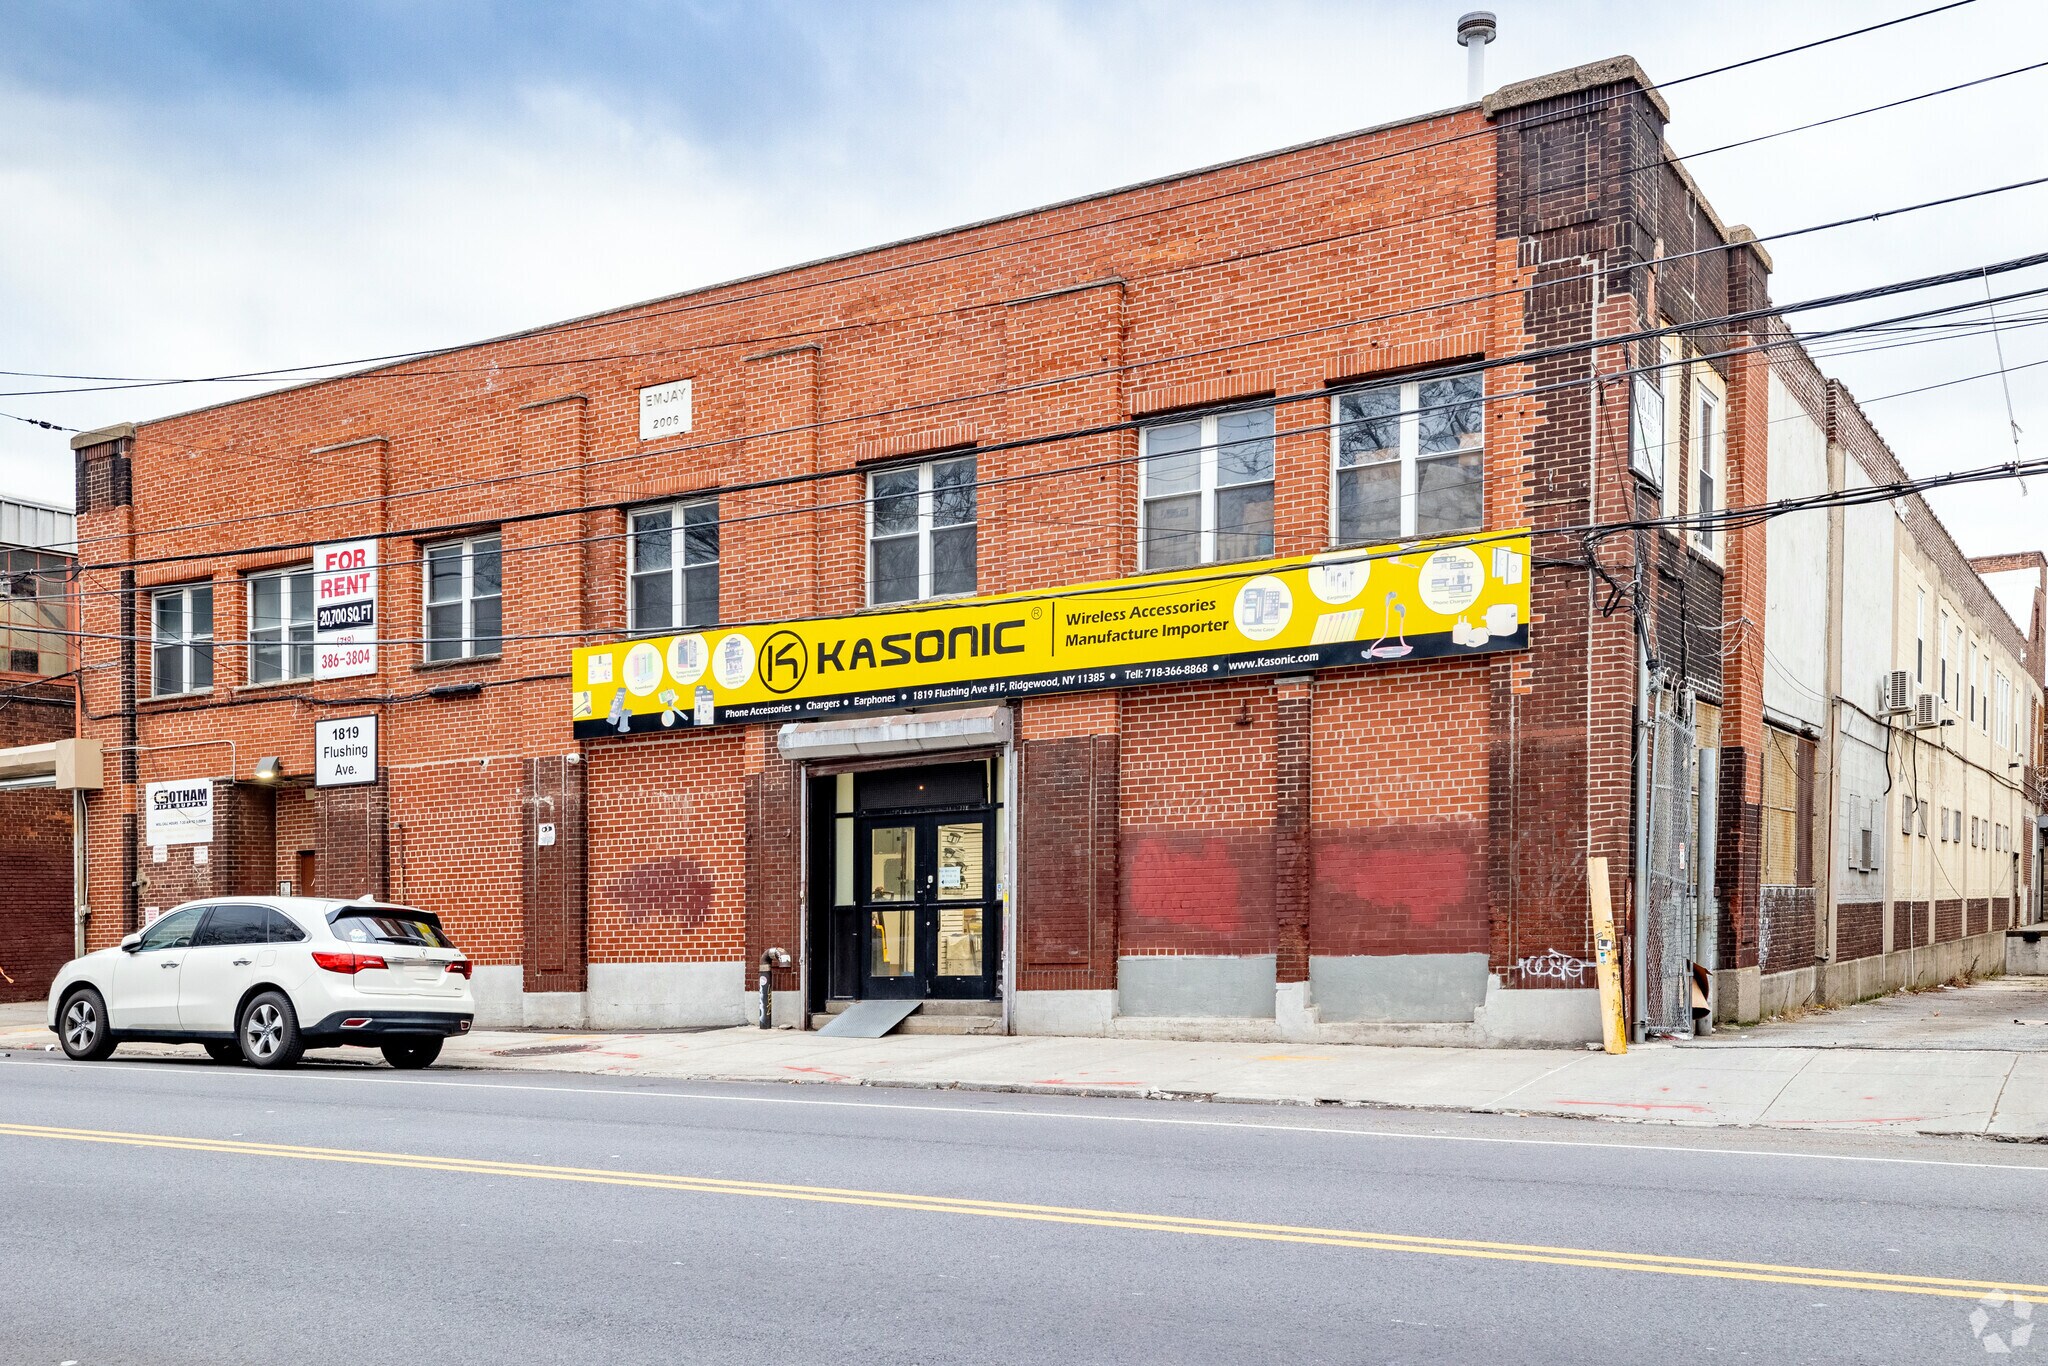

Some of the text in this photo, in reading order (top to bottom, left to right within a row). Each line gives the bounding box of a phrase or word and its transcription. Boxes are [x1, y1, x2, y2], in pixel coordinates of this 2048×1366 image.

[646, 388, 686, 407] EMJAY
[653, 415, 679, 429] 2006
[325, 548, 366, 571] FOR
[320, 572, 371, 599] RENT
[1449, 597, 1472, 606] Chargers
[320, 608, 347, 628] 20,700
[1066, 598, 1216, 626] Wireless Accessories
[1065, 619, 1229, 647] Manufacture Importer
[817, 619, 1026, 674] KASONIC
[321, 648, 370, 669] 386-3804
[725, 652, 1319, 718] Phone Accessories Chargers Earphones 1819 Flushing Ave #1F, Ridgewood, NY 11385 Tell: 718-366-8868 www.Kasonic.com
[332, 726, 359, 741] 1819
[323, 744, 368, 759] Flushing
[335, 764, 357, 776] Ave.
[154, 788, 207, 804] GOTHAM
